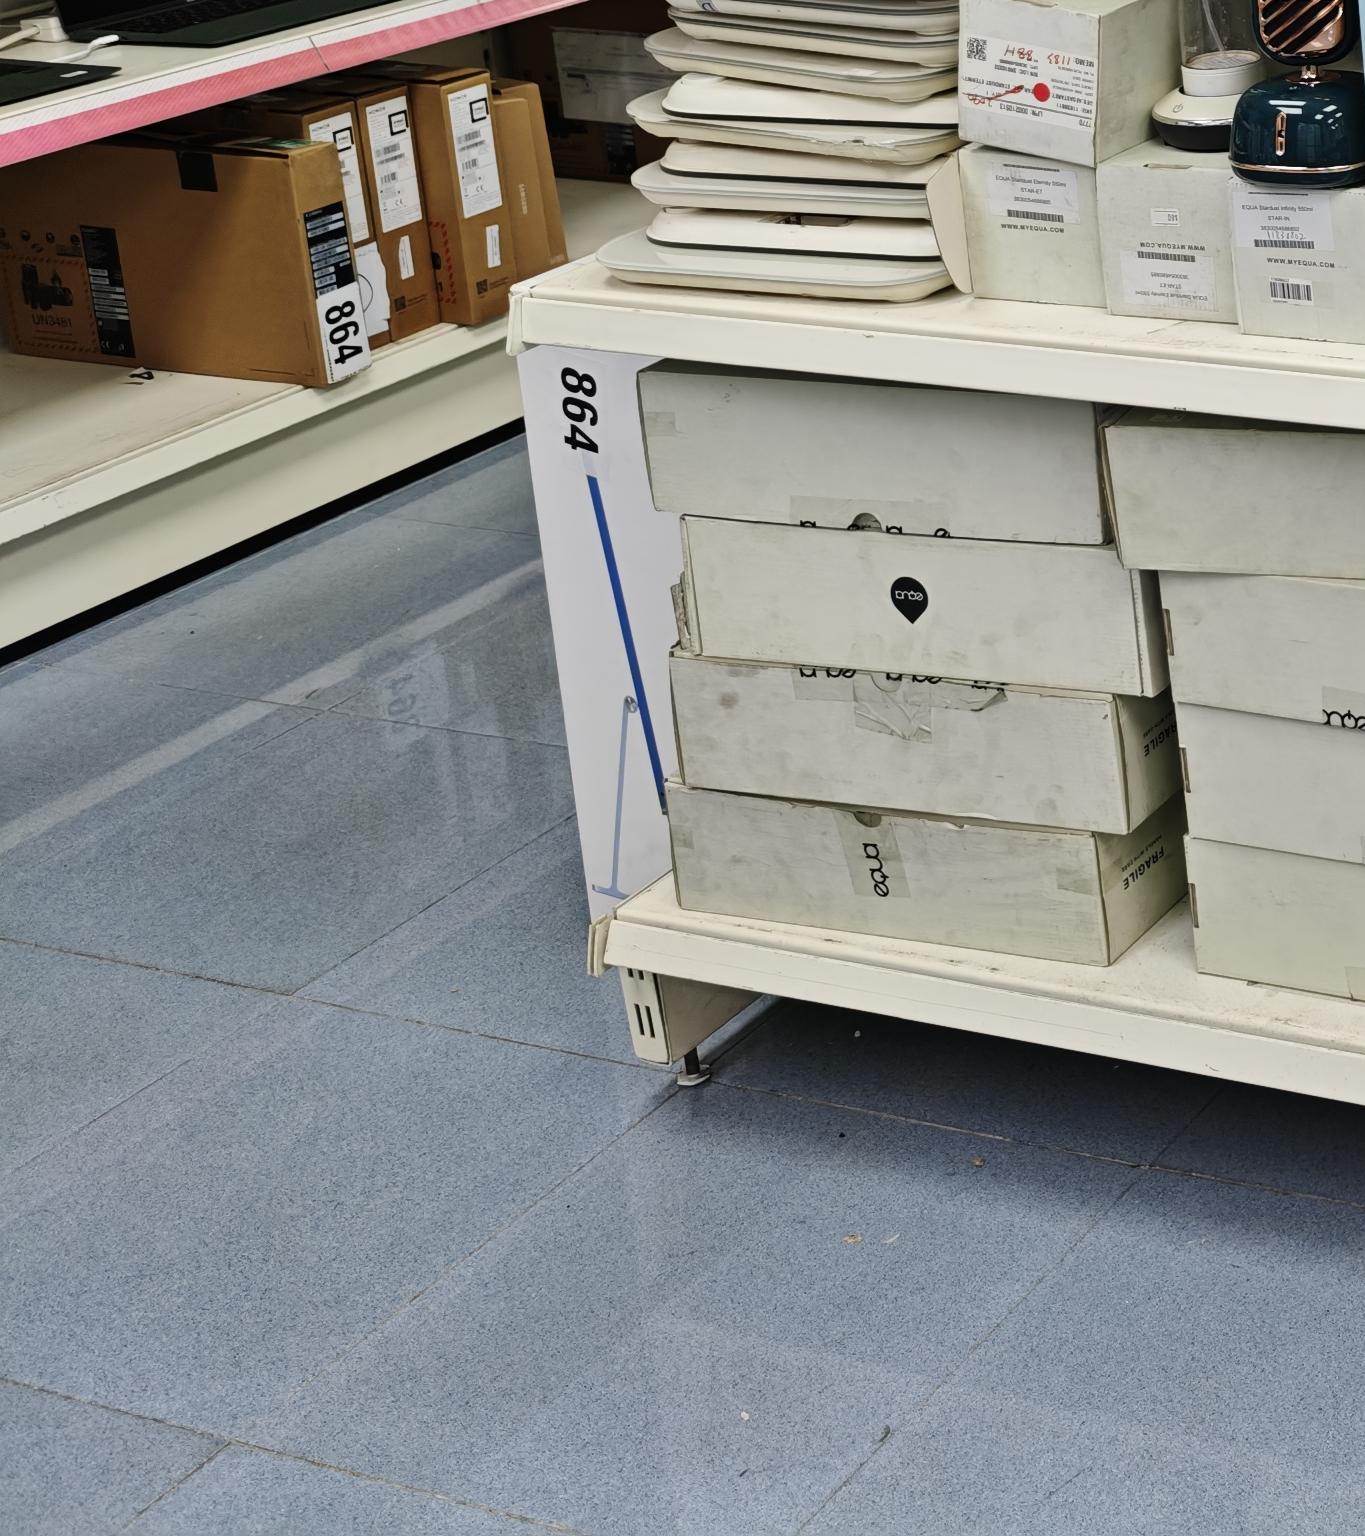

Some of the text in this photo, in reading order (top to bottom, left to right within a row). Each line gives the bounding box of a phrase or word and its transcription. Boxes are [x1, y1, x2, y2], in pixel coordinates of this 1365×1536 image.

[1000, 223, 1065, 234] WWW.MYEQUA.COM
[1266, 257, 1335, 269] WWW.MYEQUA.COM
[324, 300, 364, 366] 864
[561, 365, 599, 453] 864
[862, 843, 890, 898] equa
[1122, 845, 1165, 890] FRAGILE
